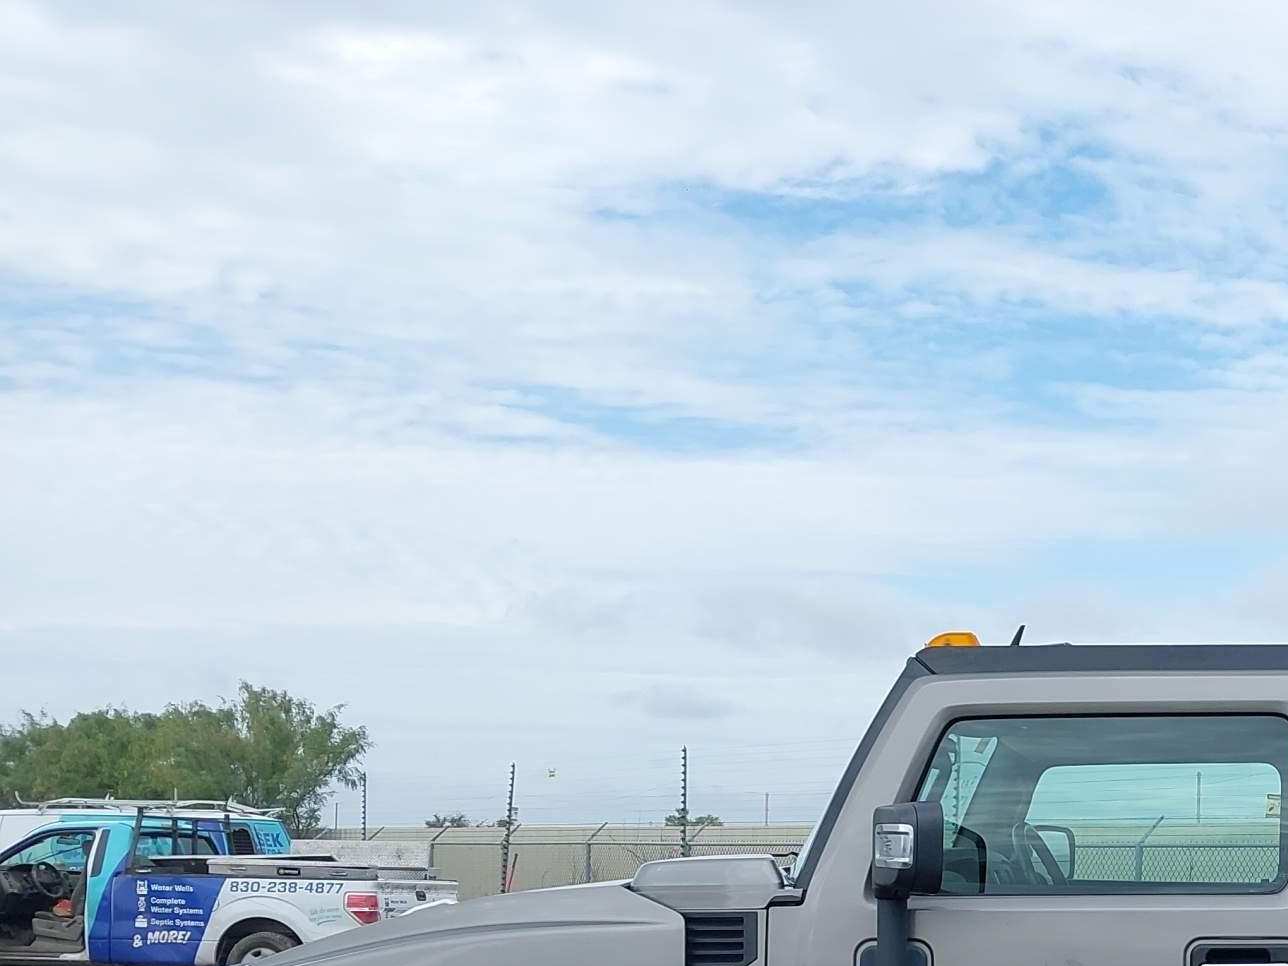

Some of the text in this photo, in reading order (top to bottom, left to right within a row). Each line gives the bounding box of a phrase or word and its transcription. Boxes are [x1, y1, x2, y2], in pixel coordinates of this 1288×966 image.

[150, 884, 194, 893] Water Wells
[229, 881, 344, 894] 830-238-4877
[150, 897, 186, 906] Complete
[150, 906, 204, 916] Water Systems
[150, 918, 205, 928] Septic Systems
[132, 930, 192, 948] & MORE!
